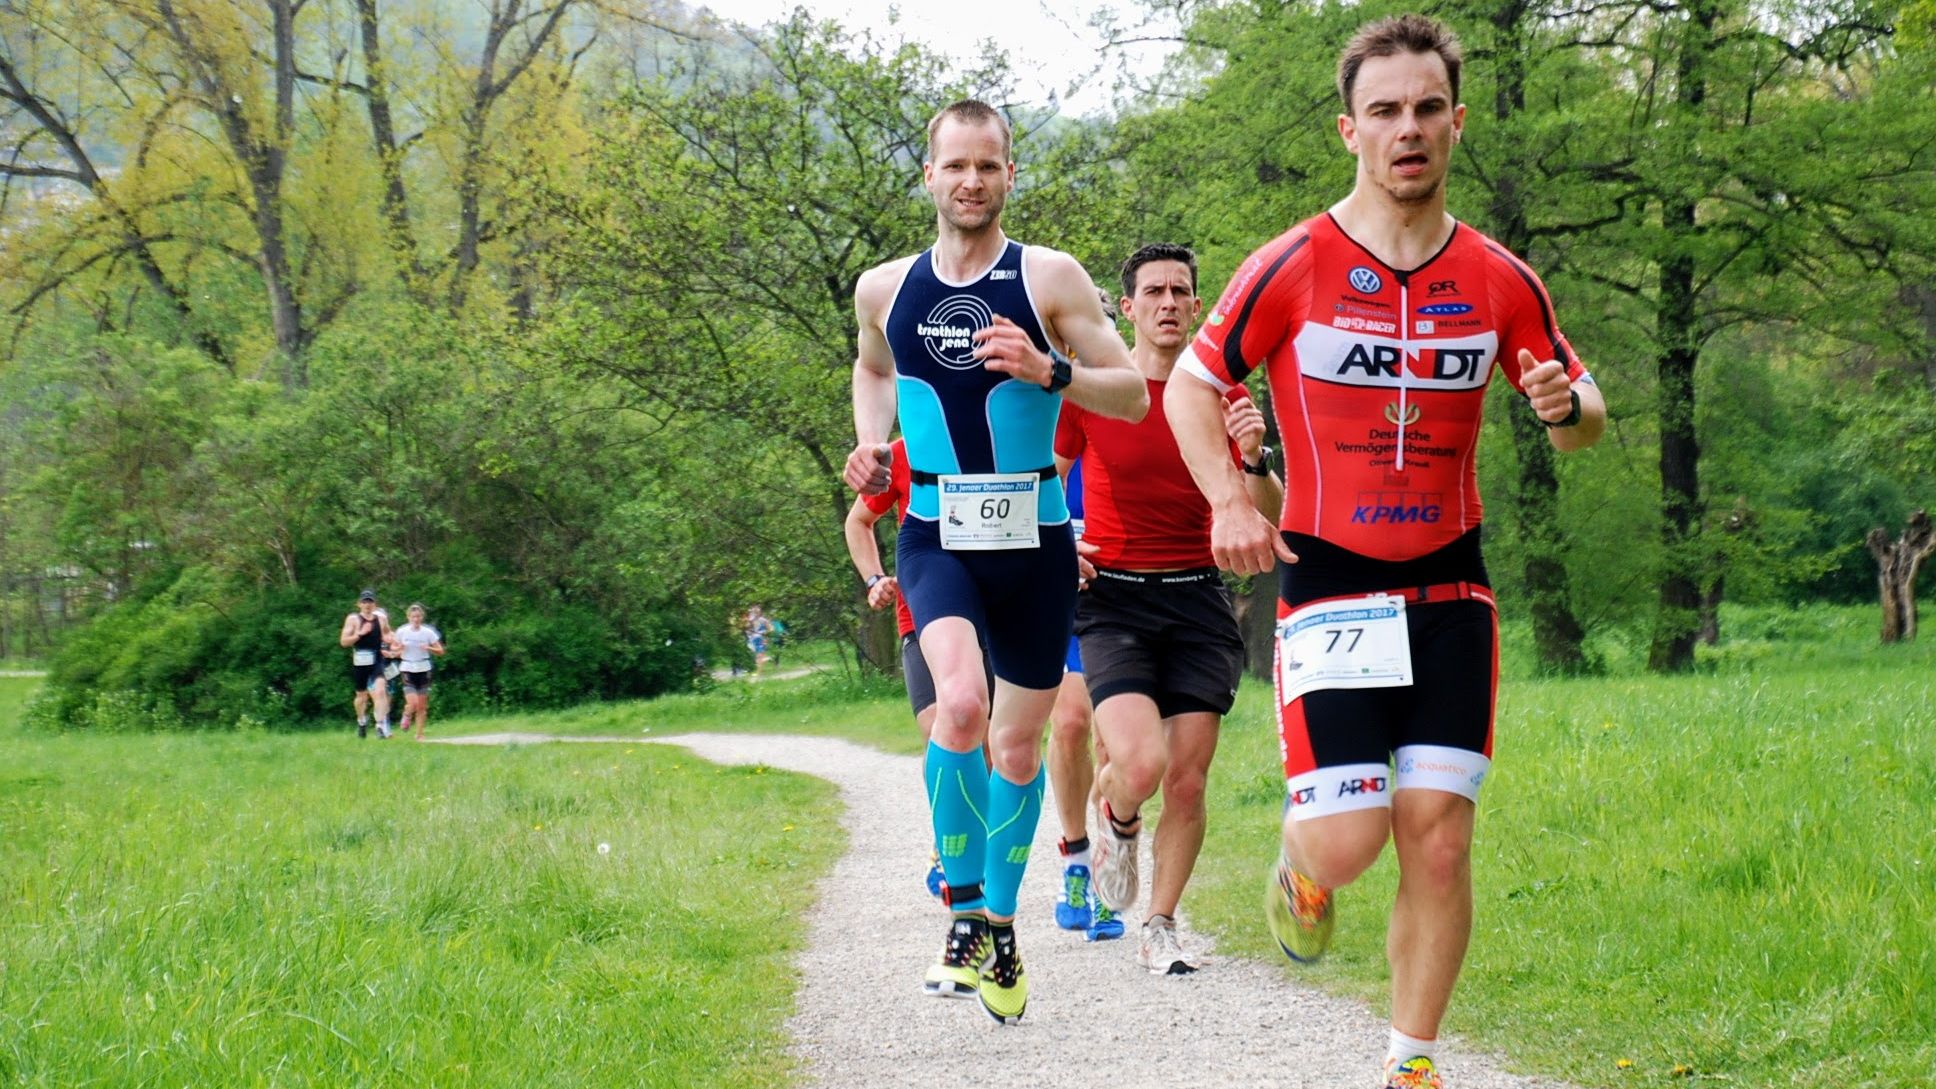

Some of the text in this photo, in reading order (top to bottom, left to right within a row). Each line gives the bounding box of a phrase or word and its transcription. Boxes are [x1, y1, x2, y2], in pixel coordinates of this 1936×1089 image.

[1424, 306, 1468, 314] ATLAS
[917, 323, 970, 337] triathlon
[940, 338, 969, 351] jena
[1336, 344, 1485, 382] ARNDT
[1368, 429, 1431, 441] Deusche
[983, 483, 1015, 491] Duathlon
[1016, 482, 1032, 490] 2017
[980, 498, 1010, 519] 60
[1352, 505, 1441, 524] KPMG
[1370, 608, 1394, 618] 2017
[1325, 628, 1364, 653] 77
